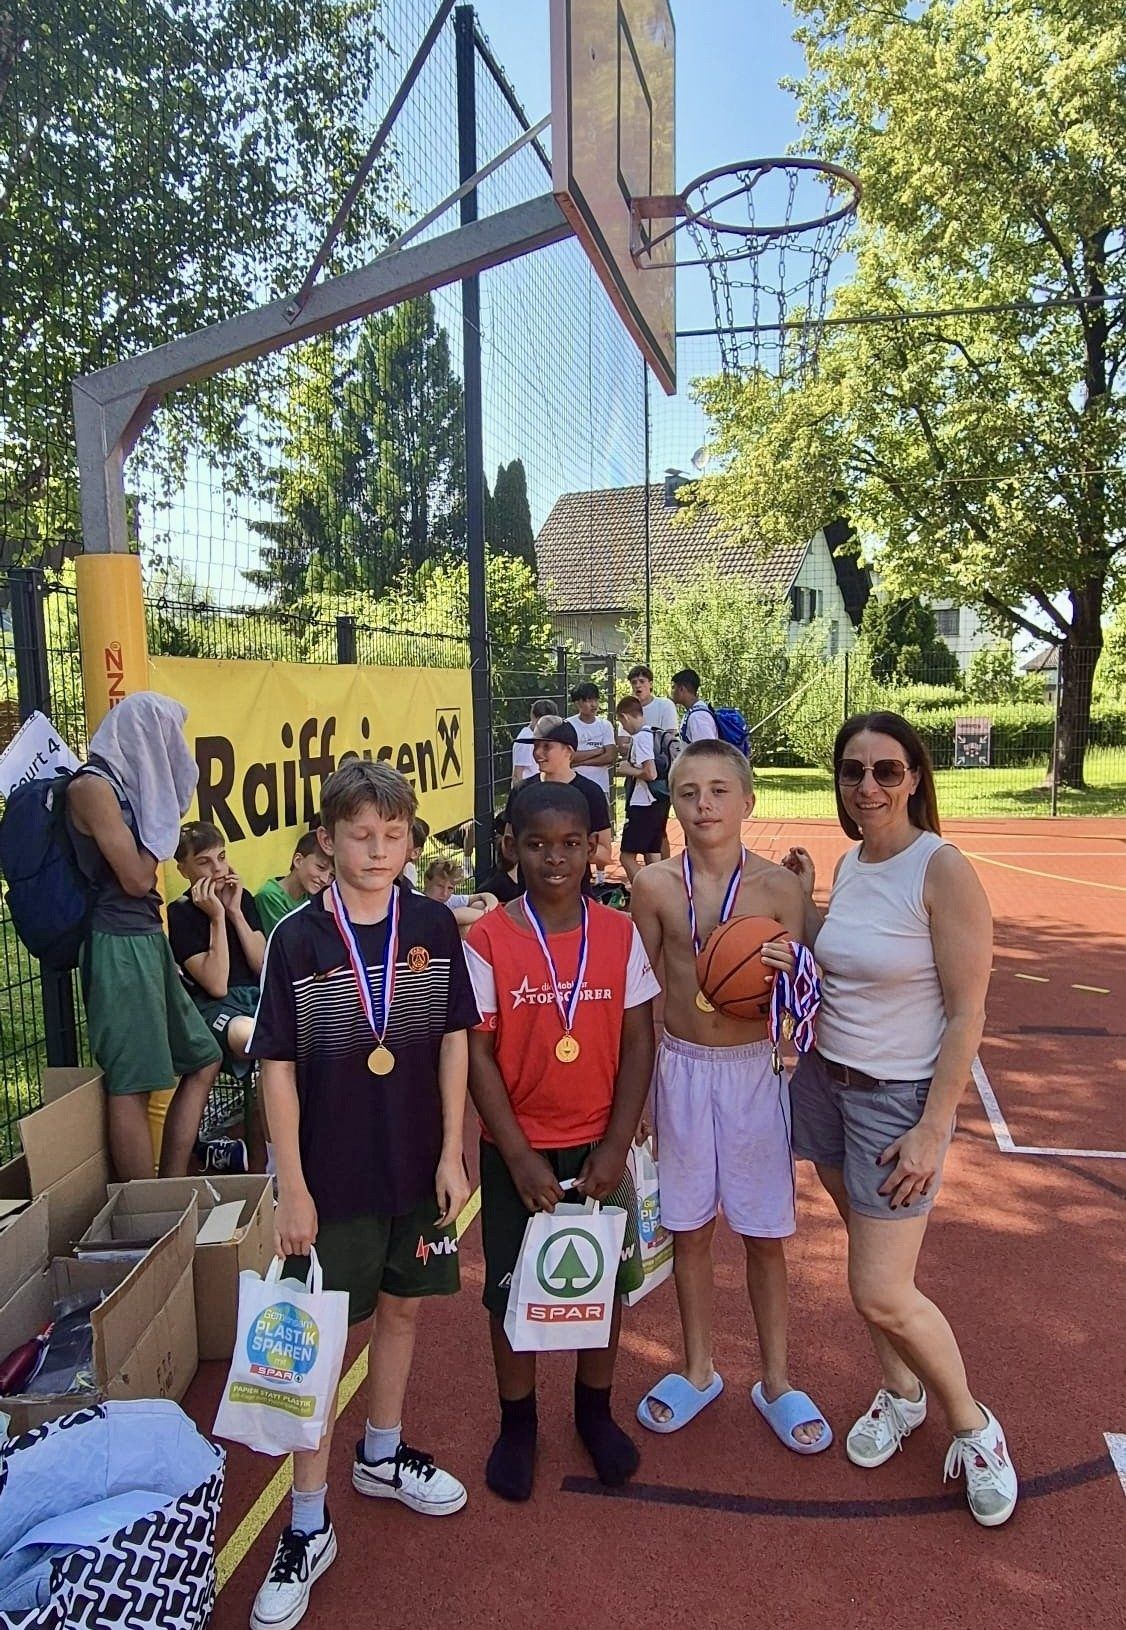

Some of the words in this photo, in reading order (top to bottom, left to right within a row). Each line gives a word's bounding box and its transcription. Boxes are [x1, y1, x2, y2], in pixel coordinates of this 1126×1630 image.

[48, 738, 60, 754] 4
[195, 716, 438, 842] Raiffien
[530, 1306, 602, 1320] SPAR
[255, 1320, 316, 1346] PLASTIK
[252, 1336, 313, 1361] SPAREN
[258, 1366, 293, 1380] SPAR
[233, 1385, 259, 1394] PAPIER
[260, 1390, 281, 1401] STATT
[283, 1396, 311, 1408] PLASTIK
